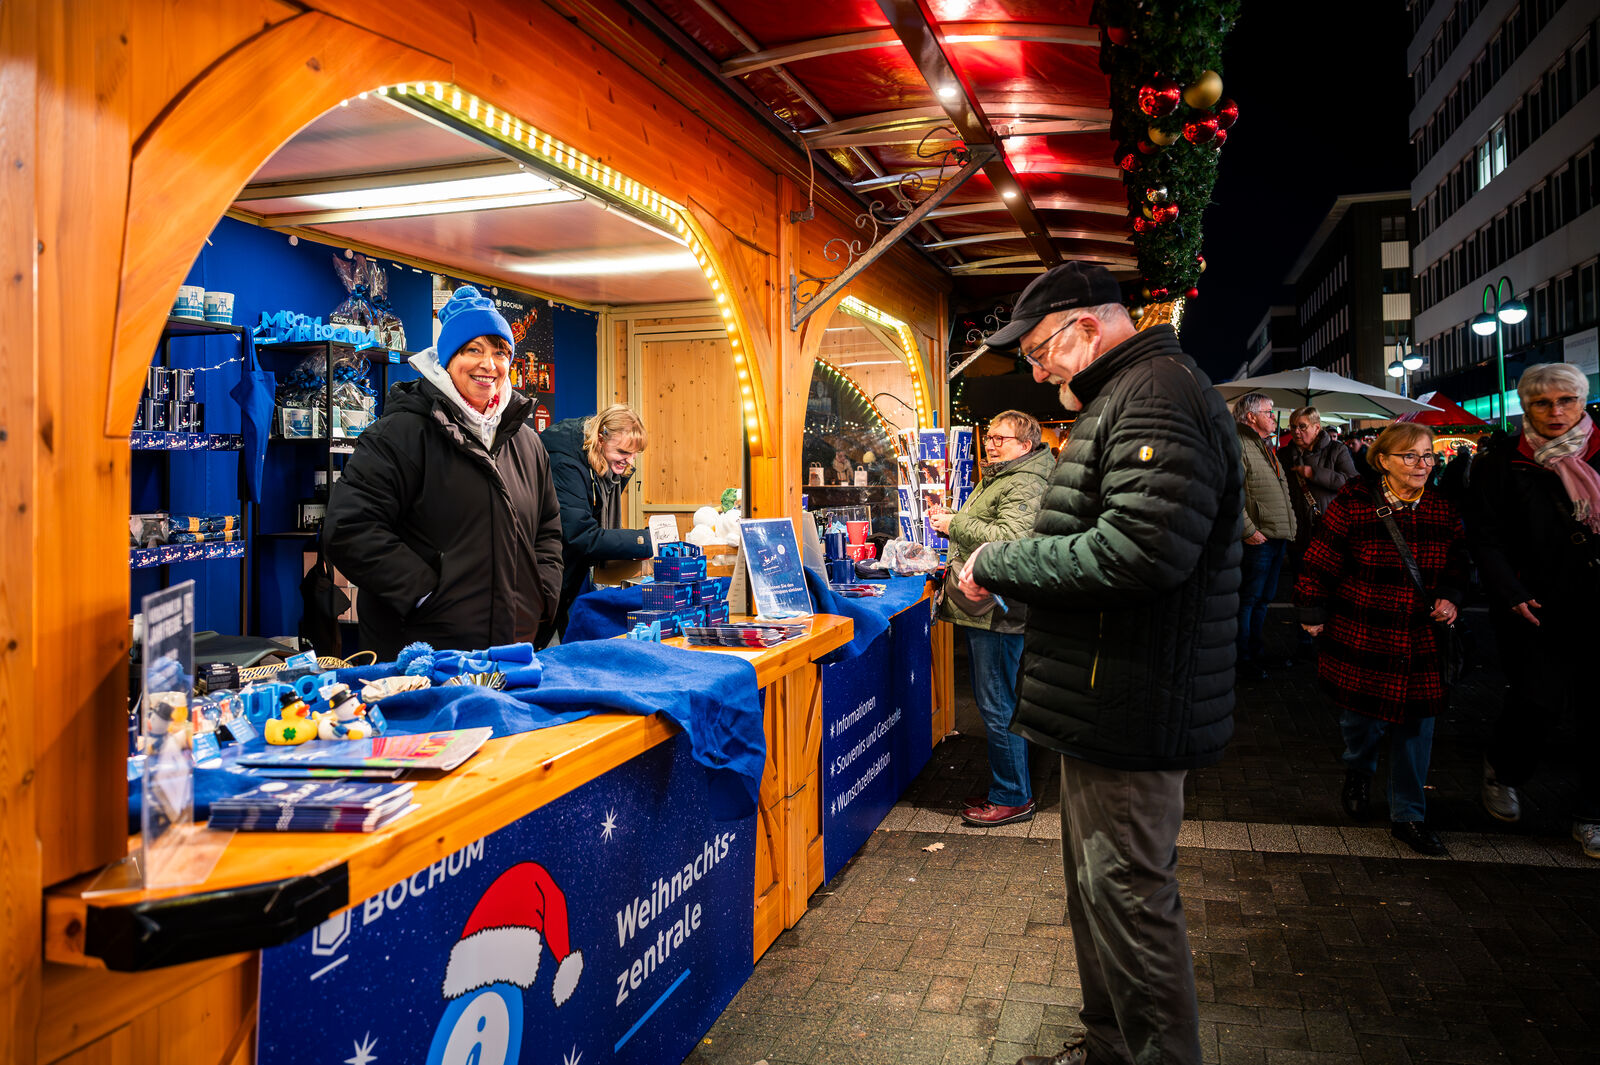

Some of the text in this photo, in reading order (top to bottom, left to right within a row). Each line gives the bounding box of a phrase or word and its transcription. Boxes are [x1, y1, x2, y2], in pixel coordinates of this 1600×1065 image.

[836, 695, 876, 737] Informationen
[836, 706, 902, 775] Souvenirs und Geschenke
[837, 751, 891, 813] Wunschzettelaktion
[362, 836, 485, 926] BOCHUM
[616, 832, 736, 948] Weihnachts-
[616, 903, 702, 1007] zentrale
